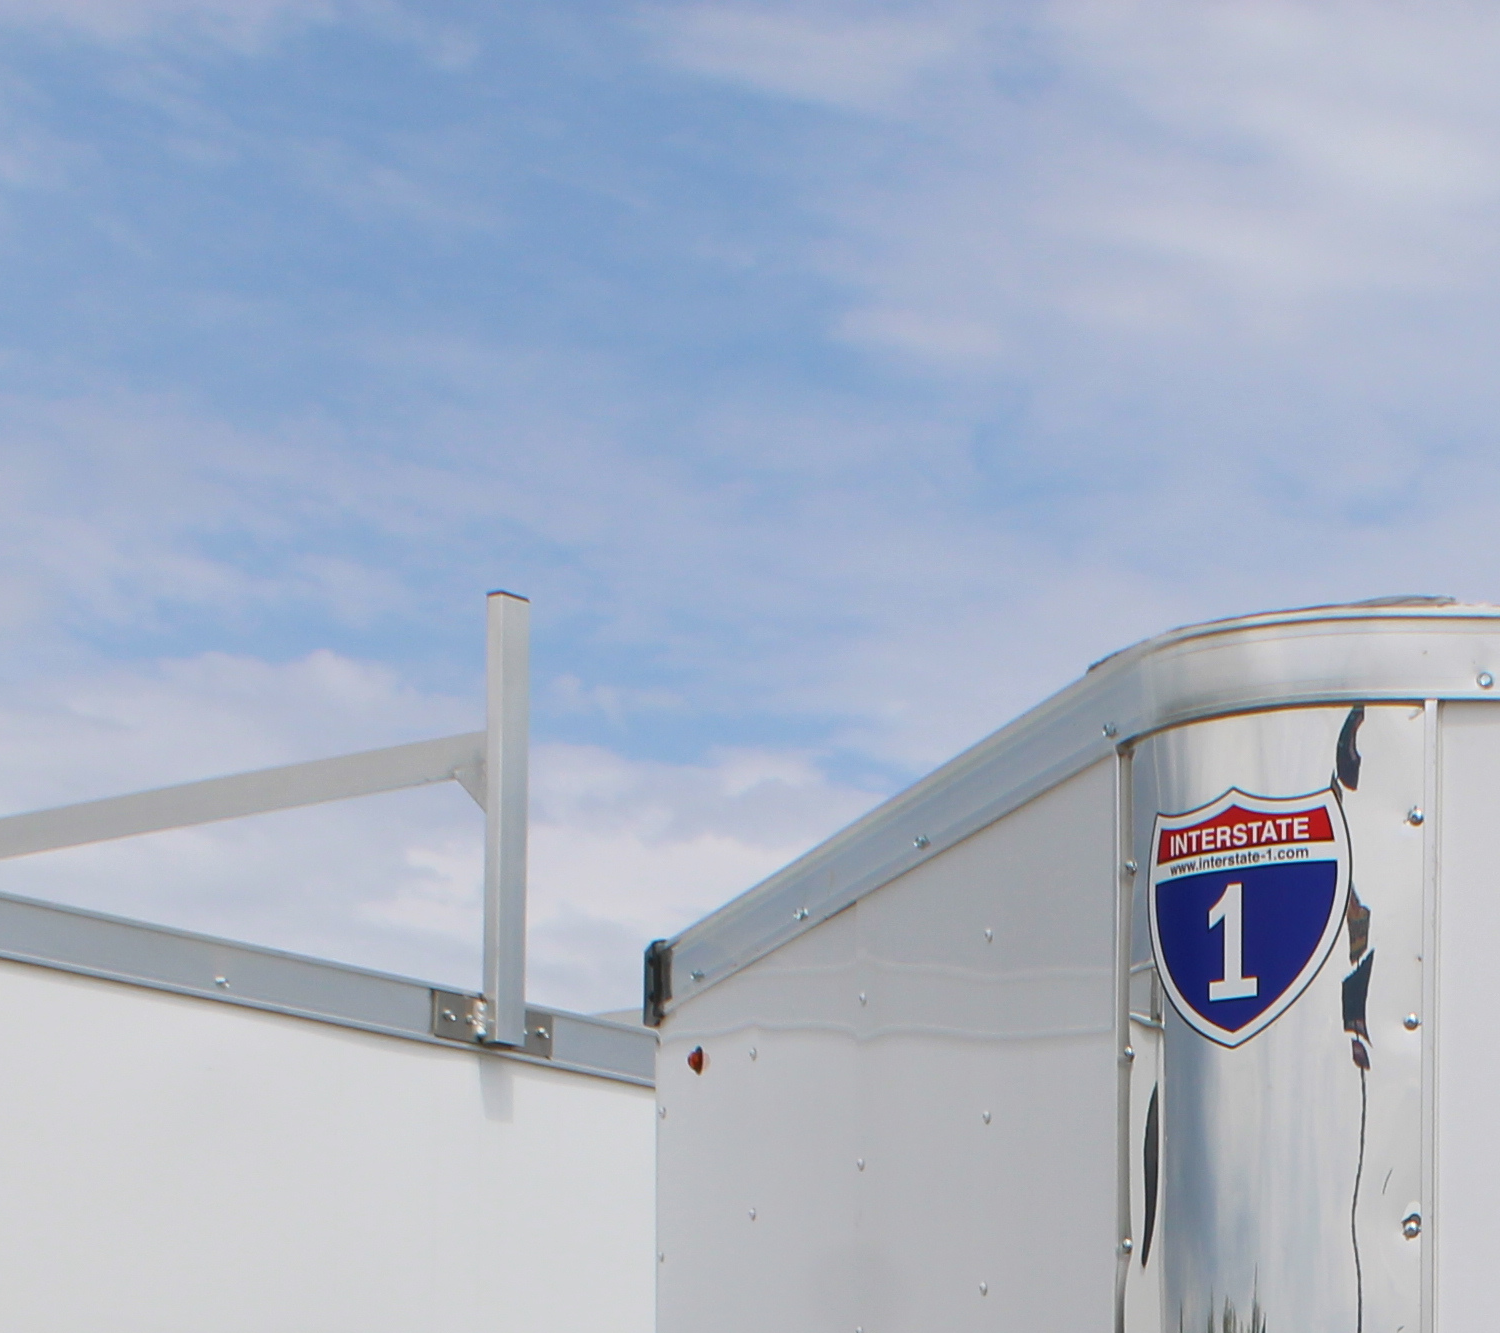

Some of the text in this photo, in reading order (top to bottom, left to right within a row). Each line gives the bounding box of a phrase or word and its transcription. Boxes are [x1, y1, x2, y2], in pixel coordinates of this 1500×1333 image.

[1169, 816, 1311, 858] INTERSTATE
[1169, 846, 1311, 877] www.interstate-1.com
[1207, 881, 1259, 1003] 1
